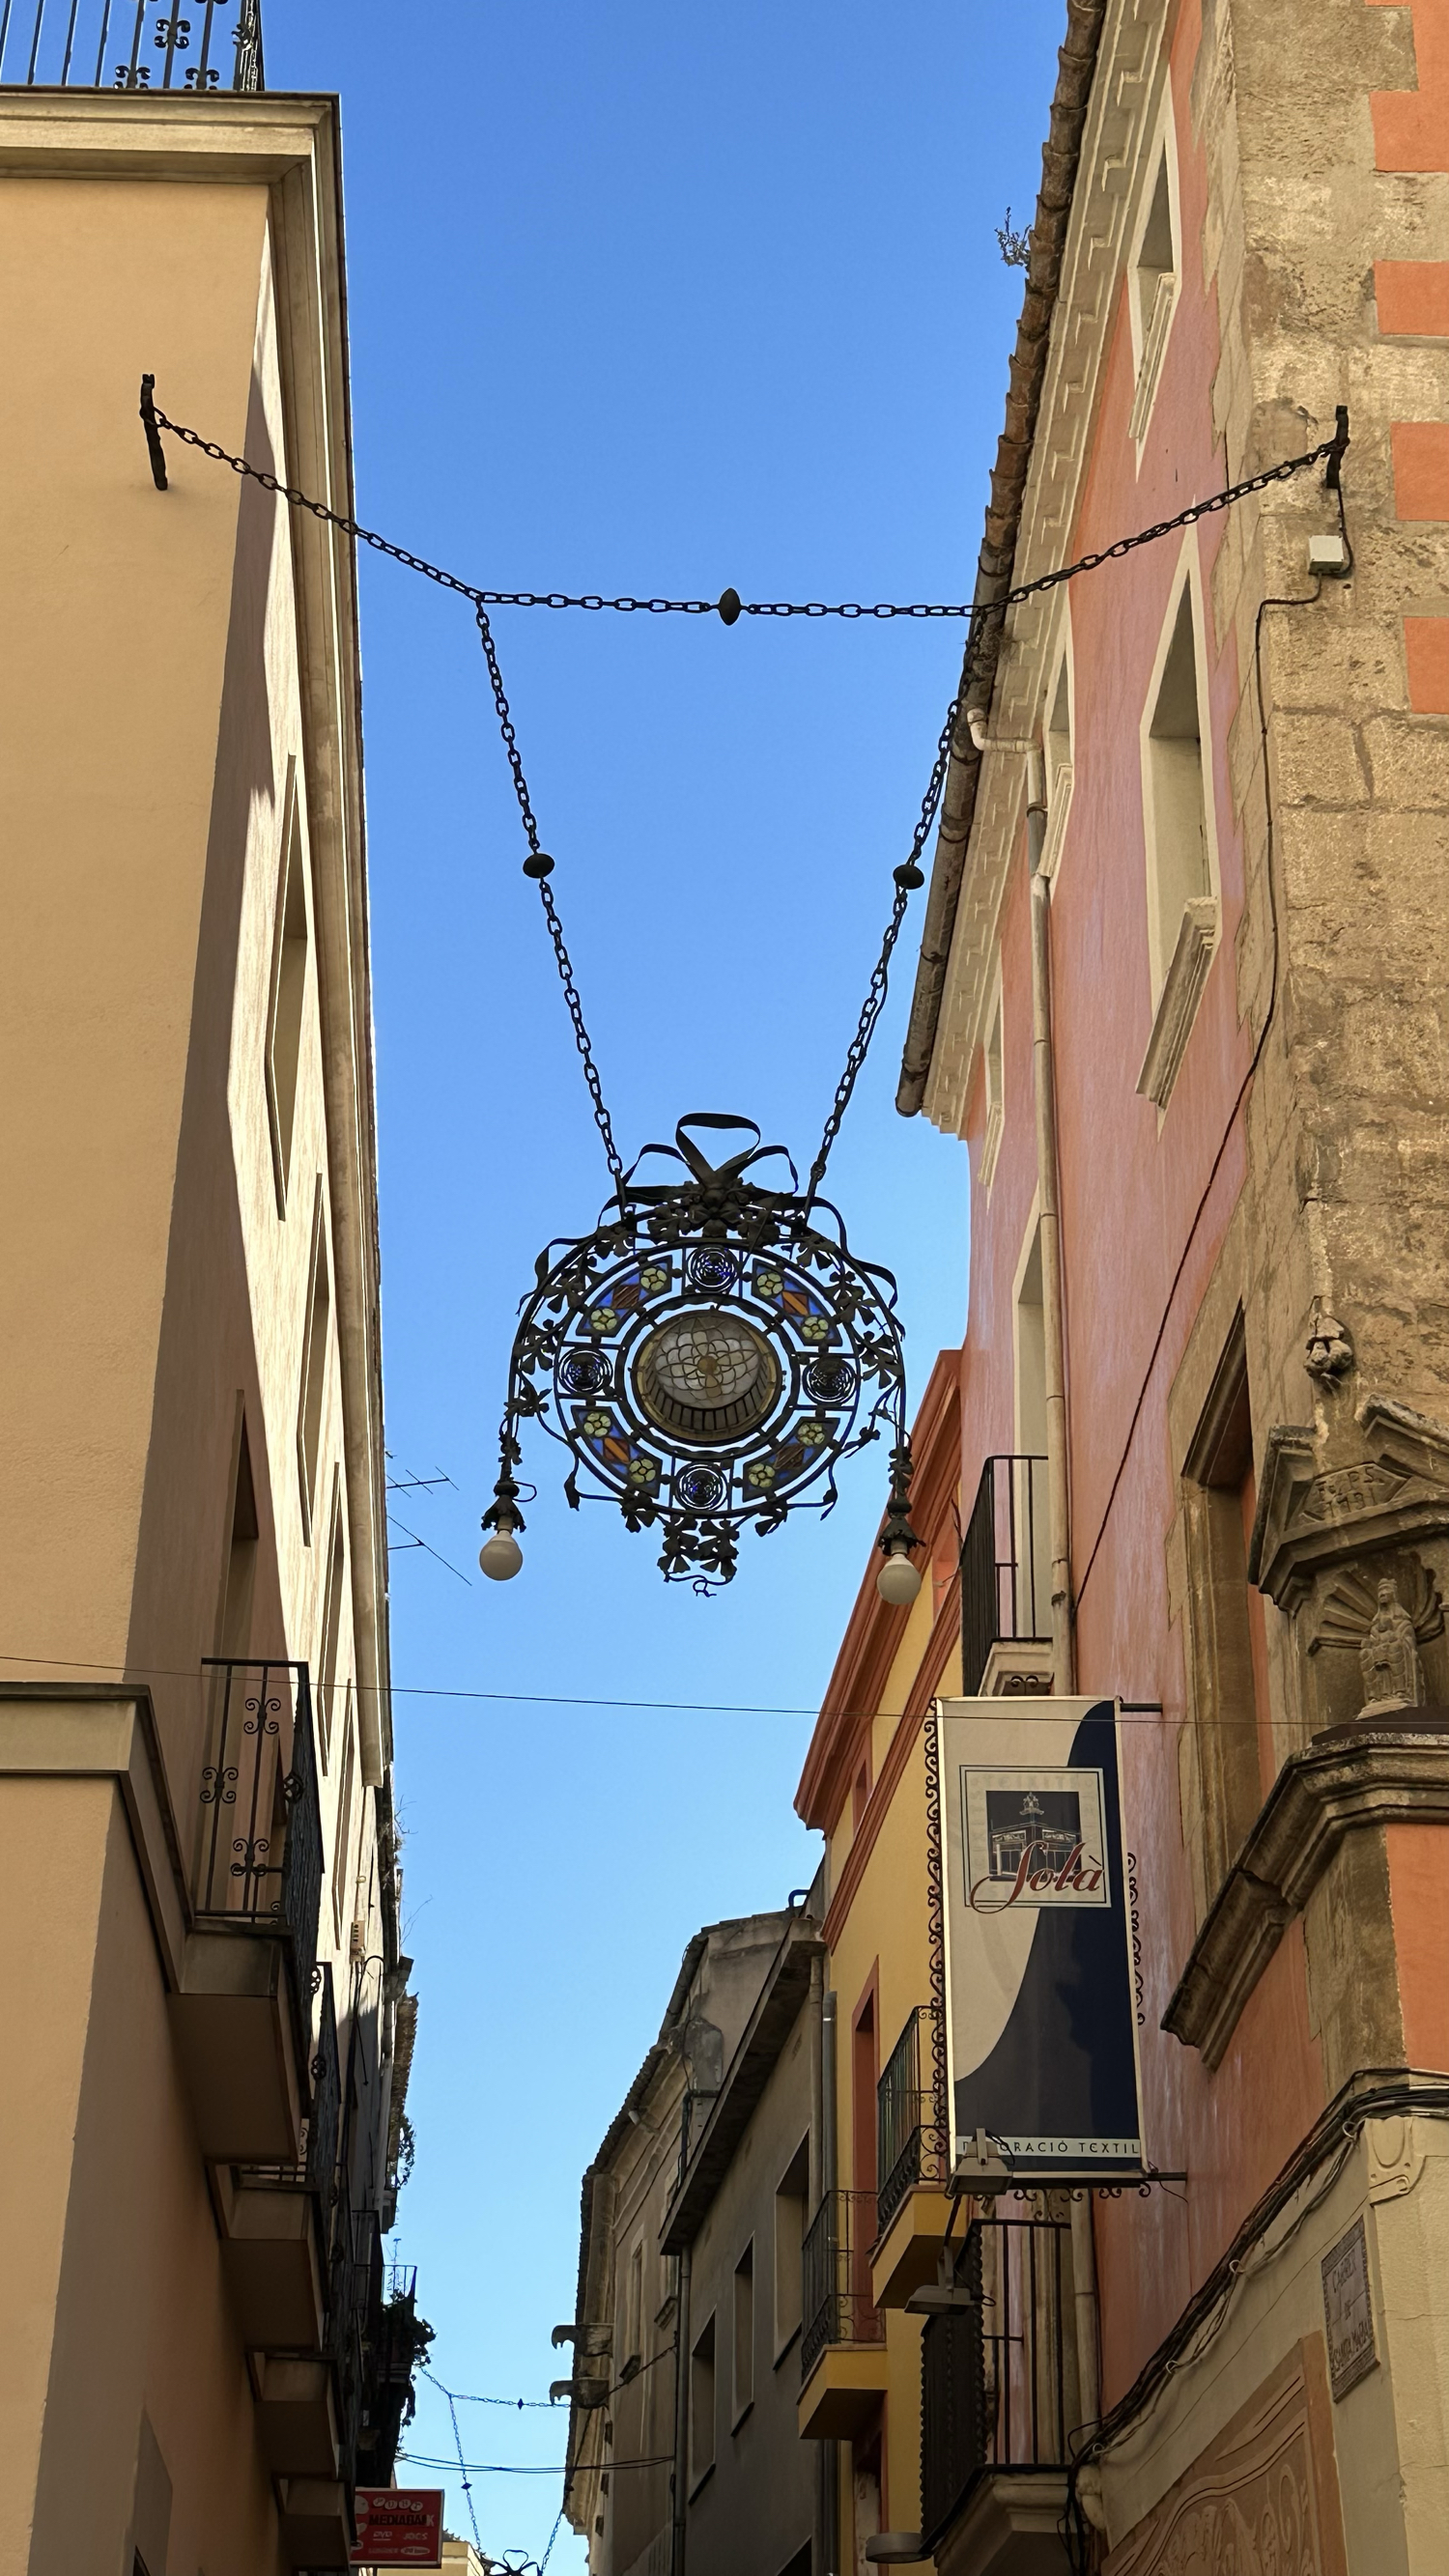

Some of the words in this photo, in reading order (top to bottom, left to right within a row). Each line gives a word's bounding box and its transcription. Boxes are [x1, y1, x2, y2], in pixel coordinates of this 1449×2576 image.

[970, 1840, 1105, 1913] Solà
[963, 2138, 1068, 2154] ORACIÓ
[1079, 2142, 1139, 2154] TEXTIL
